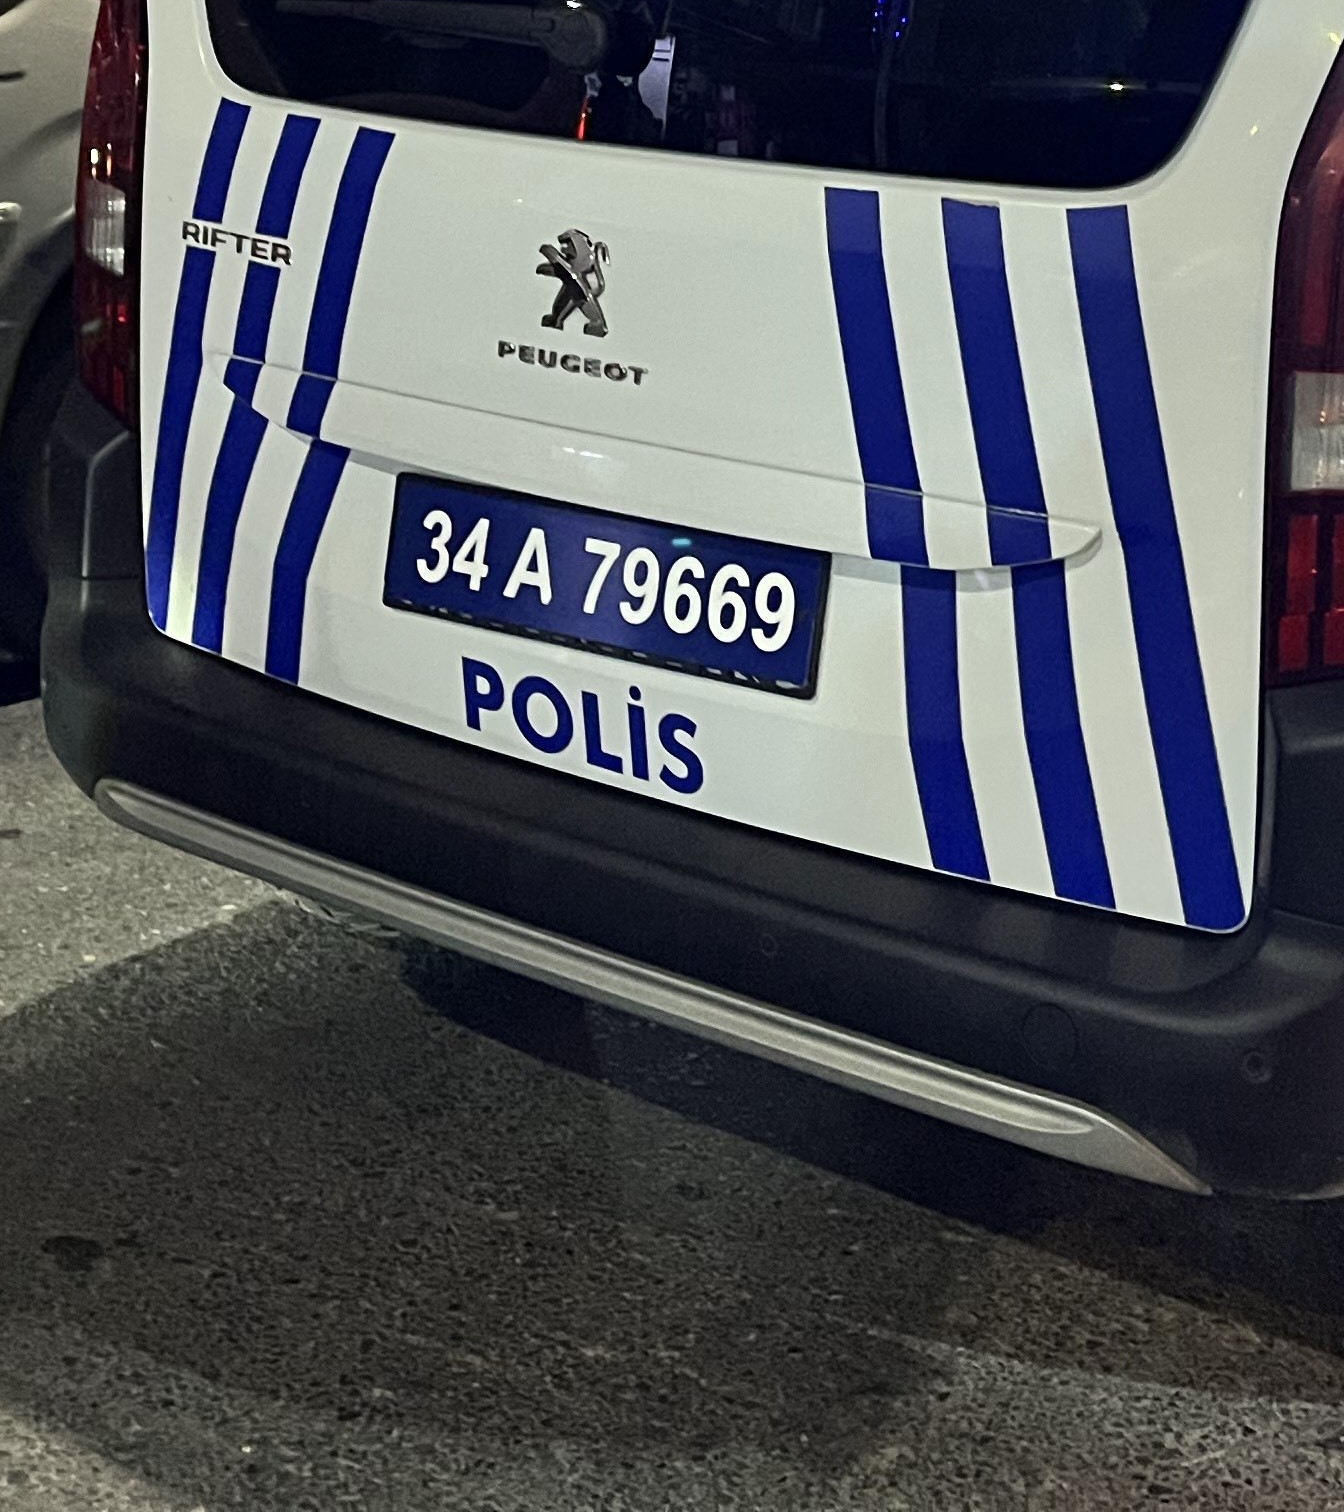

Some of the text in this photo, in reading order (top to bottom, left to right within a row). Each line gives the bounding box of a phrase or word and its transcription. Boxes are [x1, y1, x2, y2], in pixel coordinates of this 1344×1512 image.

[181, 220, 293, 266] RIFTER
[497, 340, 649, 386] PEUGEOT
[416, 510, 796, 653] 34 A 79669
[461, 655, 705, 795] POLİS
